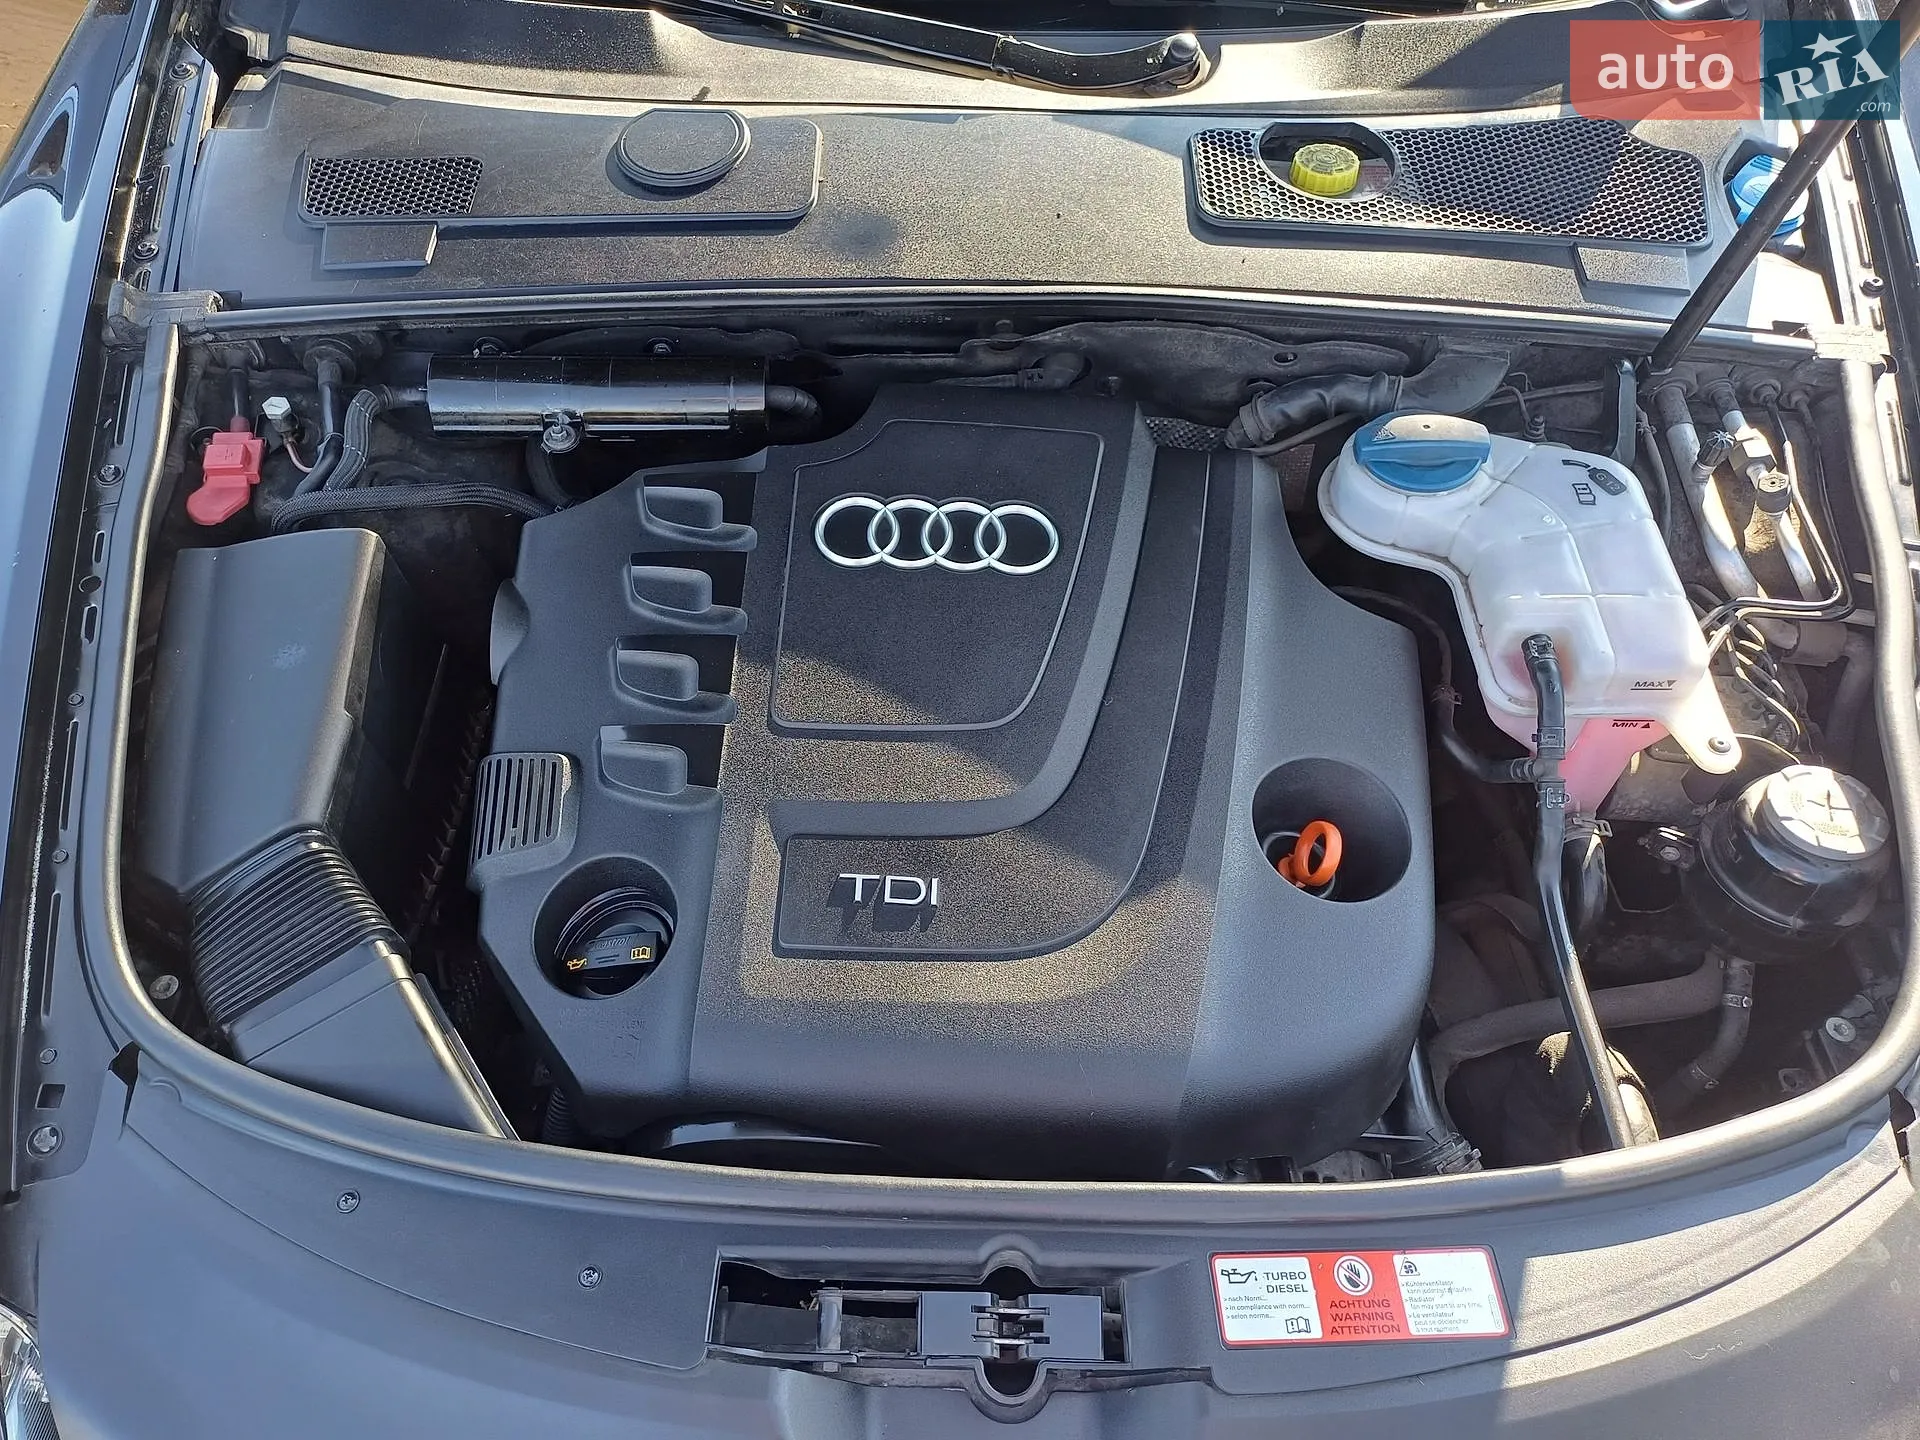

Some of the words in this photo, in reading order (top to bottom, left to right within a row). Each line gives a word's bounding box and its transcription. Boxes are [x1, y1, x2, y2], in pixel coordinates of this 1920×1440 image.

[1634, 680, 1665, 688] MAX
[839, 873, 939, 906] TDI
[1264, 1271, 1307, 1281] TURBO
[1266, 1284, 1309, 1293] DIESEL
[1237, 1304, 1272, 1313] compliance
[1329, 1298, 1391, 1309] ACHTUNG
[1330, 1311, 1393, 1322] WARNING
[1331, 1324, 1401, 1336] ATTENTION
